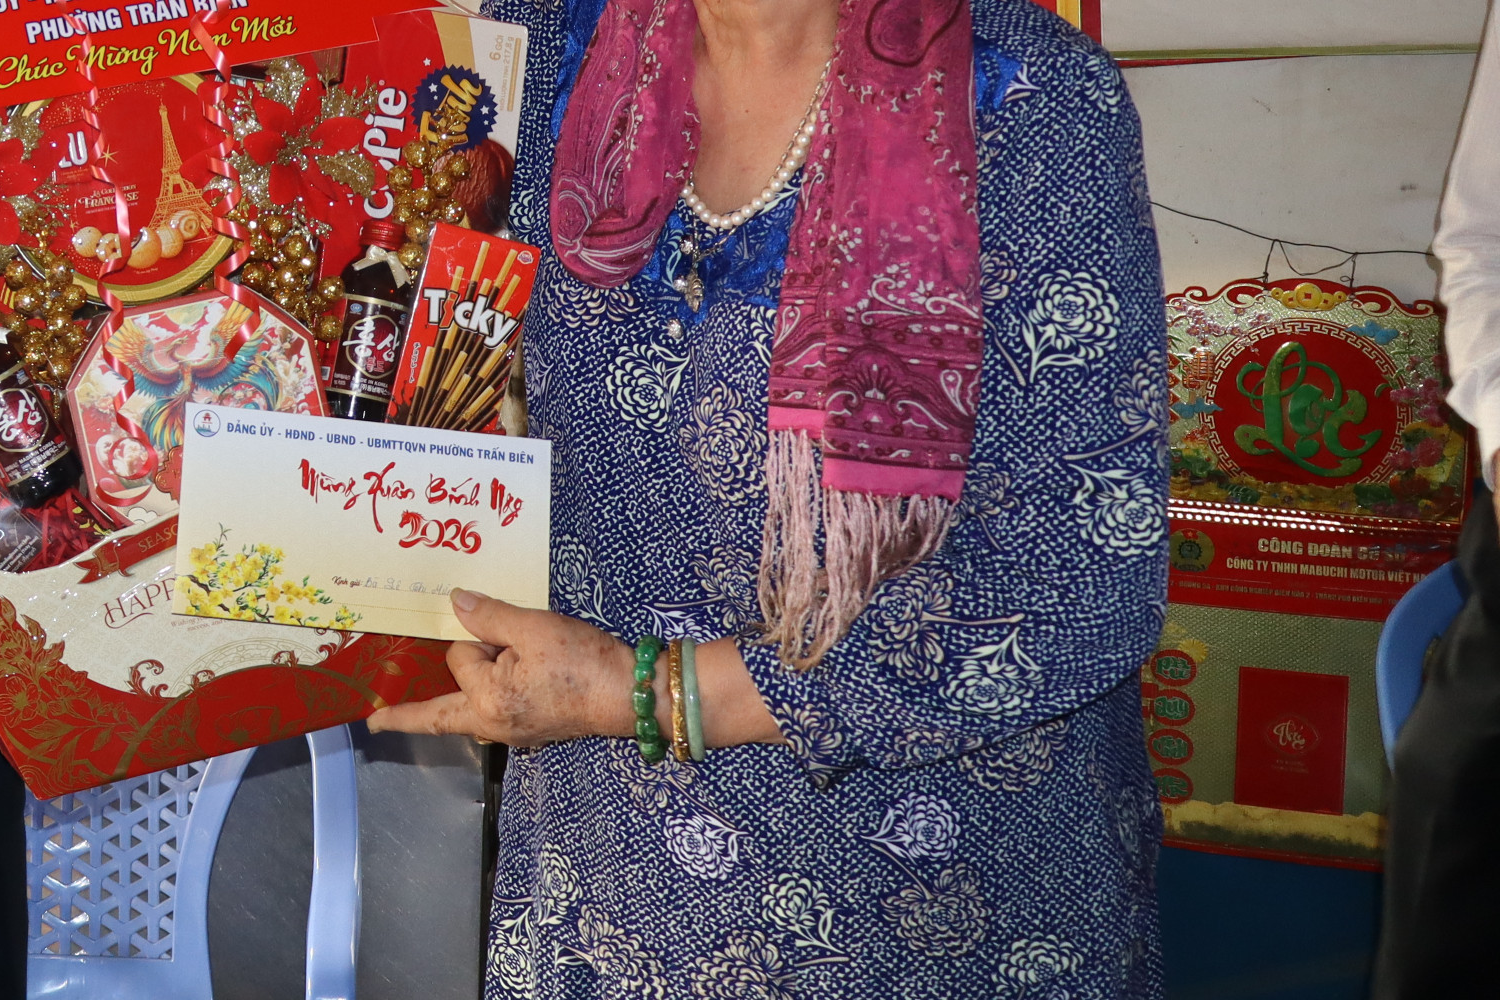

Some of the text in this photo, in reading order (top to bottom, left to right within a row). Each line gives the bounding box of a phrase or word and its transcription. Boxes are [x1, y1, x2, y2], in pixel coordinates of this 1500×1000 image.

[231, 15, 297, 43] Mới
[423, 287, 519, 348] Ticky
[227, 420, 256, 435] ĐẢNG
[260, 422, 274, 437] ỦY
[285, 429, 315, 441] HĐND
[327, 433, 356, 446] UBND
[367, 437, 426, 453] UBMTTQVN
[430, 443, 474, 458] PHƯỜNG
[477, 446, 505, 461] TRẤN
[509, 451, 534, 464] BIÊN
[298, 458, 364, 510] Mừng
[363, 461, 415, 534] Xuân
[425, 473, 480, 506] Bính
[398, 509, 482, 554] 2026
[1257, 537, 1304, 556] CÔNG
[1307, 541, 1352, 559] ĐOÀN
[1226, 556, 1427, 584] CÔNG TY TNHH MABUCHI MOTOR VIỆT NA
[103, 577, 176, 629] HAPP
